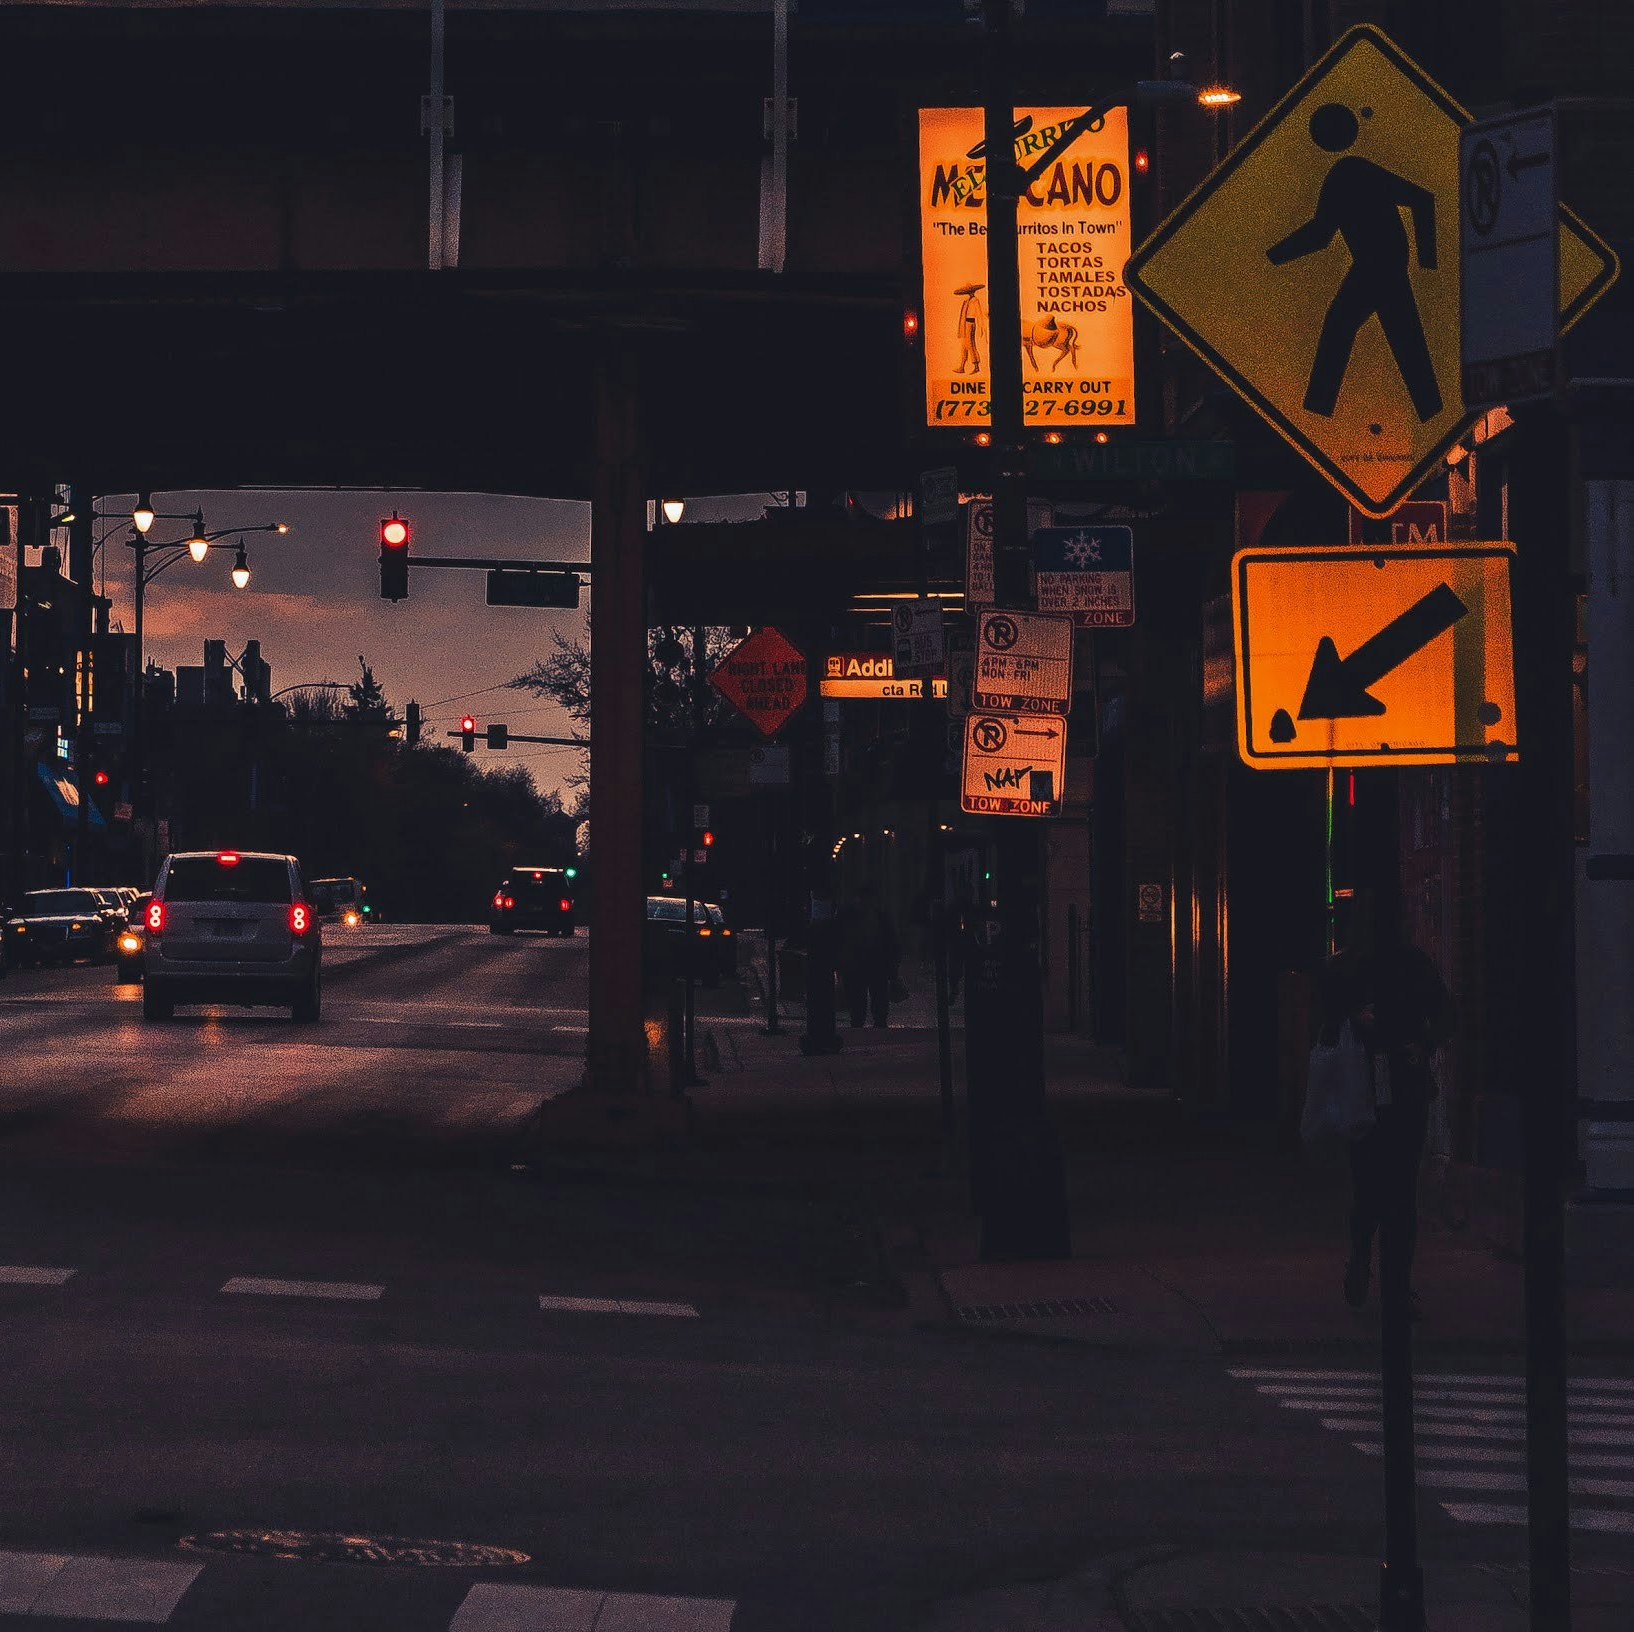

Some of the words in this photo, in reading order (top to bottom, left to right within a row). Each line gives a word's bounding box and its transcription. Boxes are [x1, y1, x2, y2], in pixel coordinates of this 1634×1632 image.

[931, 162, 1122, 208] MECANO
[1016, 222, 1058, 235] urritos
[1062, 222, 1074, 234] In
[1037, 242, 1093, 254] TACOS
[1037, 256, 1104, 268] TORTAS
[1037, 271, 1115, 283] TAMALES
[1037, 285, 1127, 298] TOSTADAS
[1037, 300, 1108, 312] NACHOS
[950, 382, 986, 394] DINE
[1023, 381, 1074, 394] CARRY
[1081, 381, 1112, 394] OUT
[1025, 399, 1128, 417] 27-6991
[1074, 445, 1197, 475] WILTON
[1040, 575, 1054, 584] NO
[1059, 574, 1102, 584] PARKING
[1041, 586, 1067, 595] WHEN
[1071, 586, 1102, 595] SNOW
[1107, 586, 1117, 595] IS
[1041, 597, 1067, 607] OVER
[1072, 597, 1078, 607] 2
[1084, 597, 1119, 607] INCHES
[1084, 612, 1123, 625] ZONE
[728, 662, 766, 675] RIGHT
[773, 662, 807, 674] LANE
[741, 678, 794, 693] CLOSED
[882, 685, 904, 696] cta
[746, 697, 789, 711] AHEAD
[981, 694, 1013, 708] TOW
[1021, 698, 1060, 712] ZONE
[968, 796, 1001, 811] TOW
